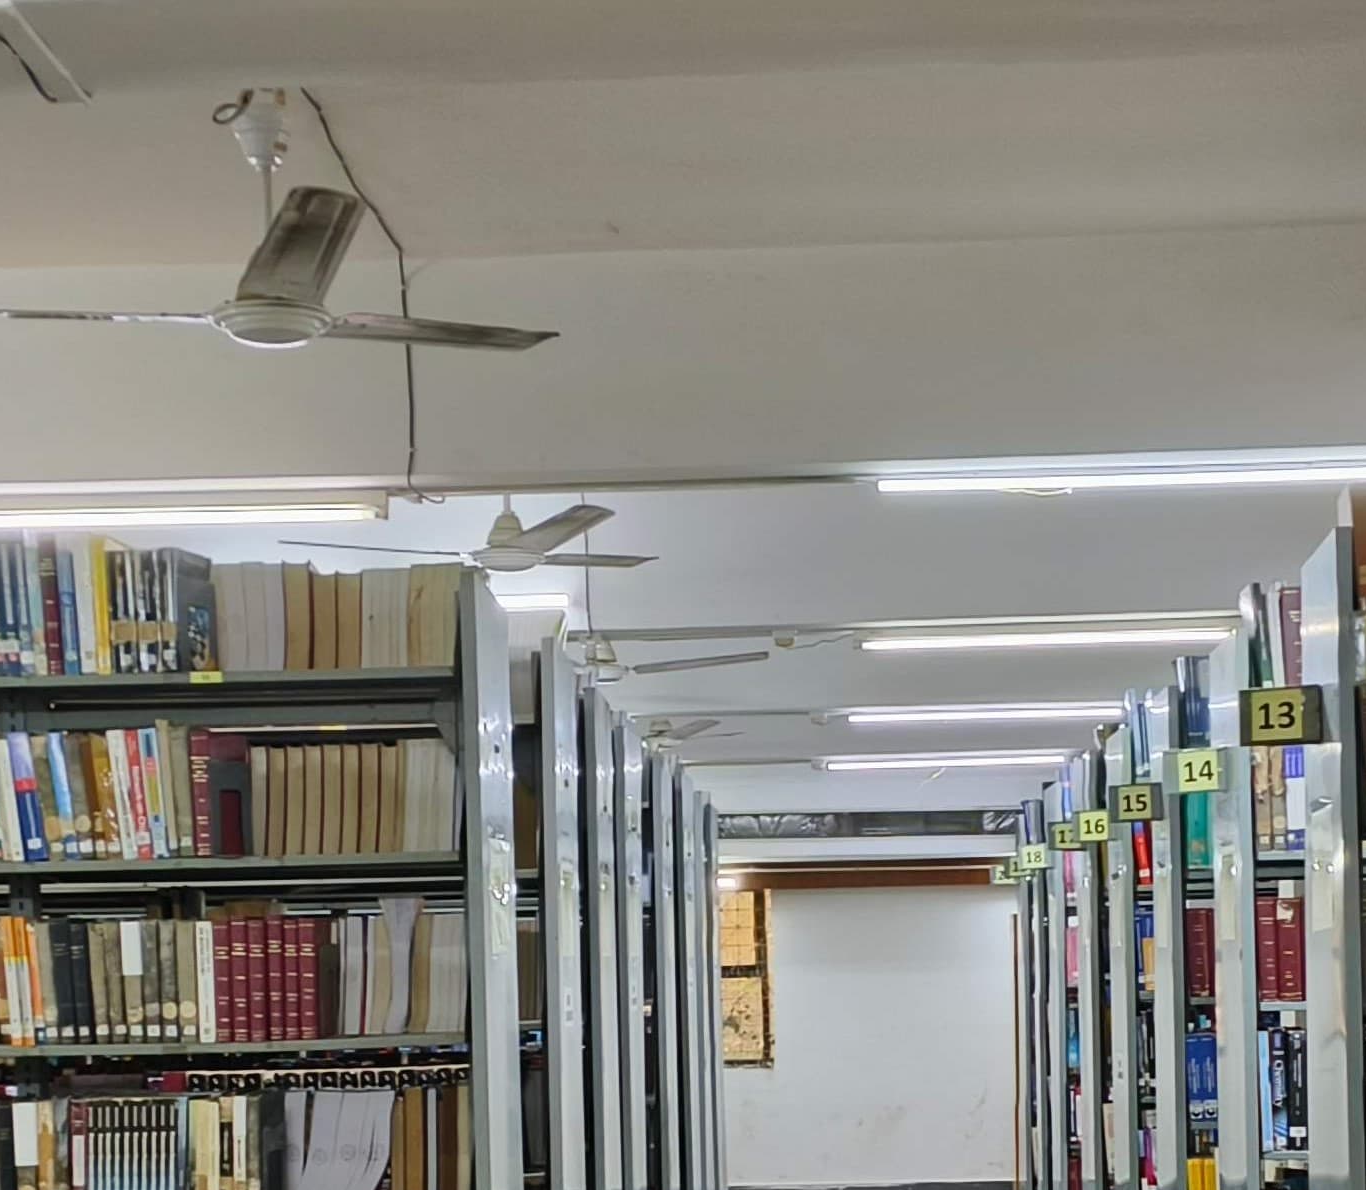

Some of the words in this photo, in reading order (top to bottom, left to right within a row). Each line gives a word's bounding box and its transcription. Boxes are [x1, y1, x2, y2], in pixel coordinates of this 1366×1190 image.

[1258, 701, 1297, 730] 13
[1183, 759, 1215, 783] 14
[1121, 793, 1148, 813] 15
[1083, 818, 1106, 835] 16
[1026, 850, 1043, 864] 18
